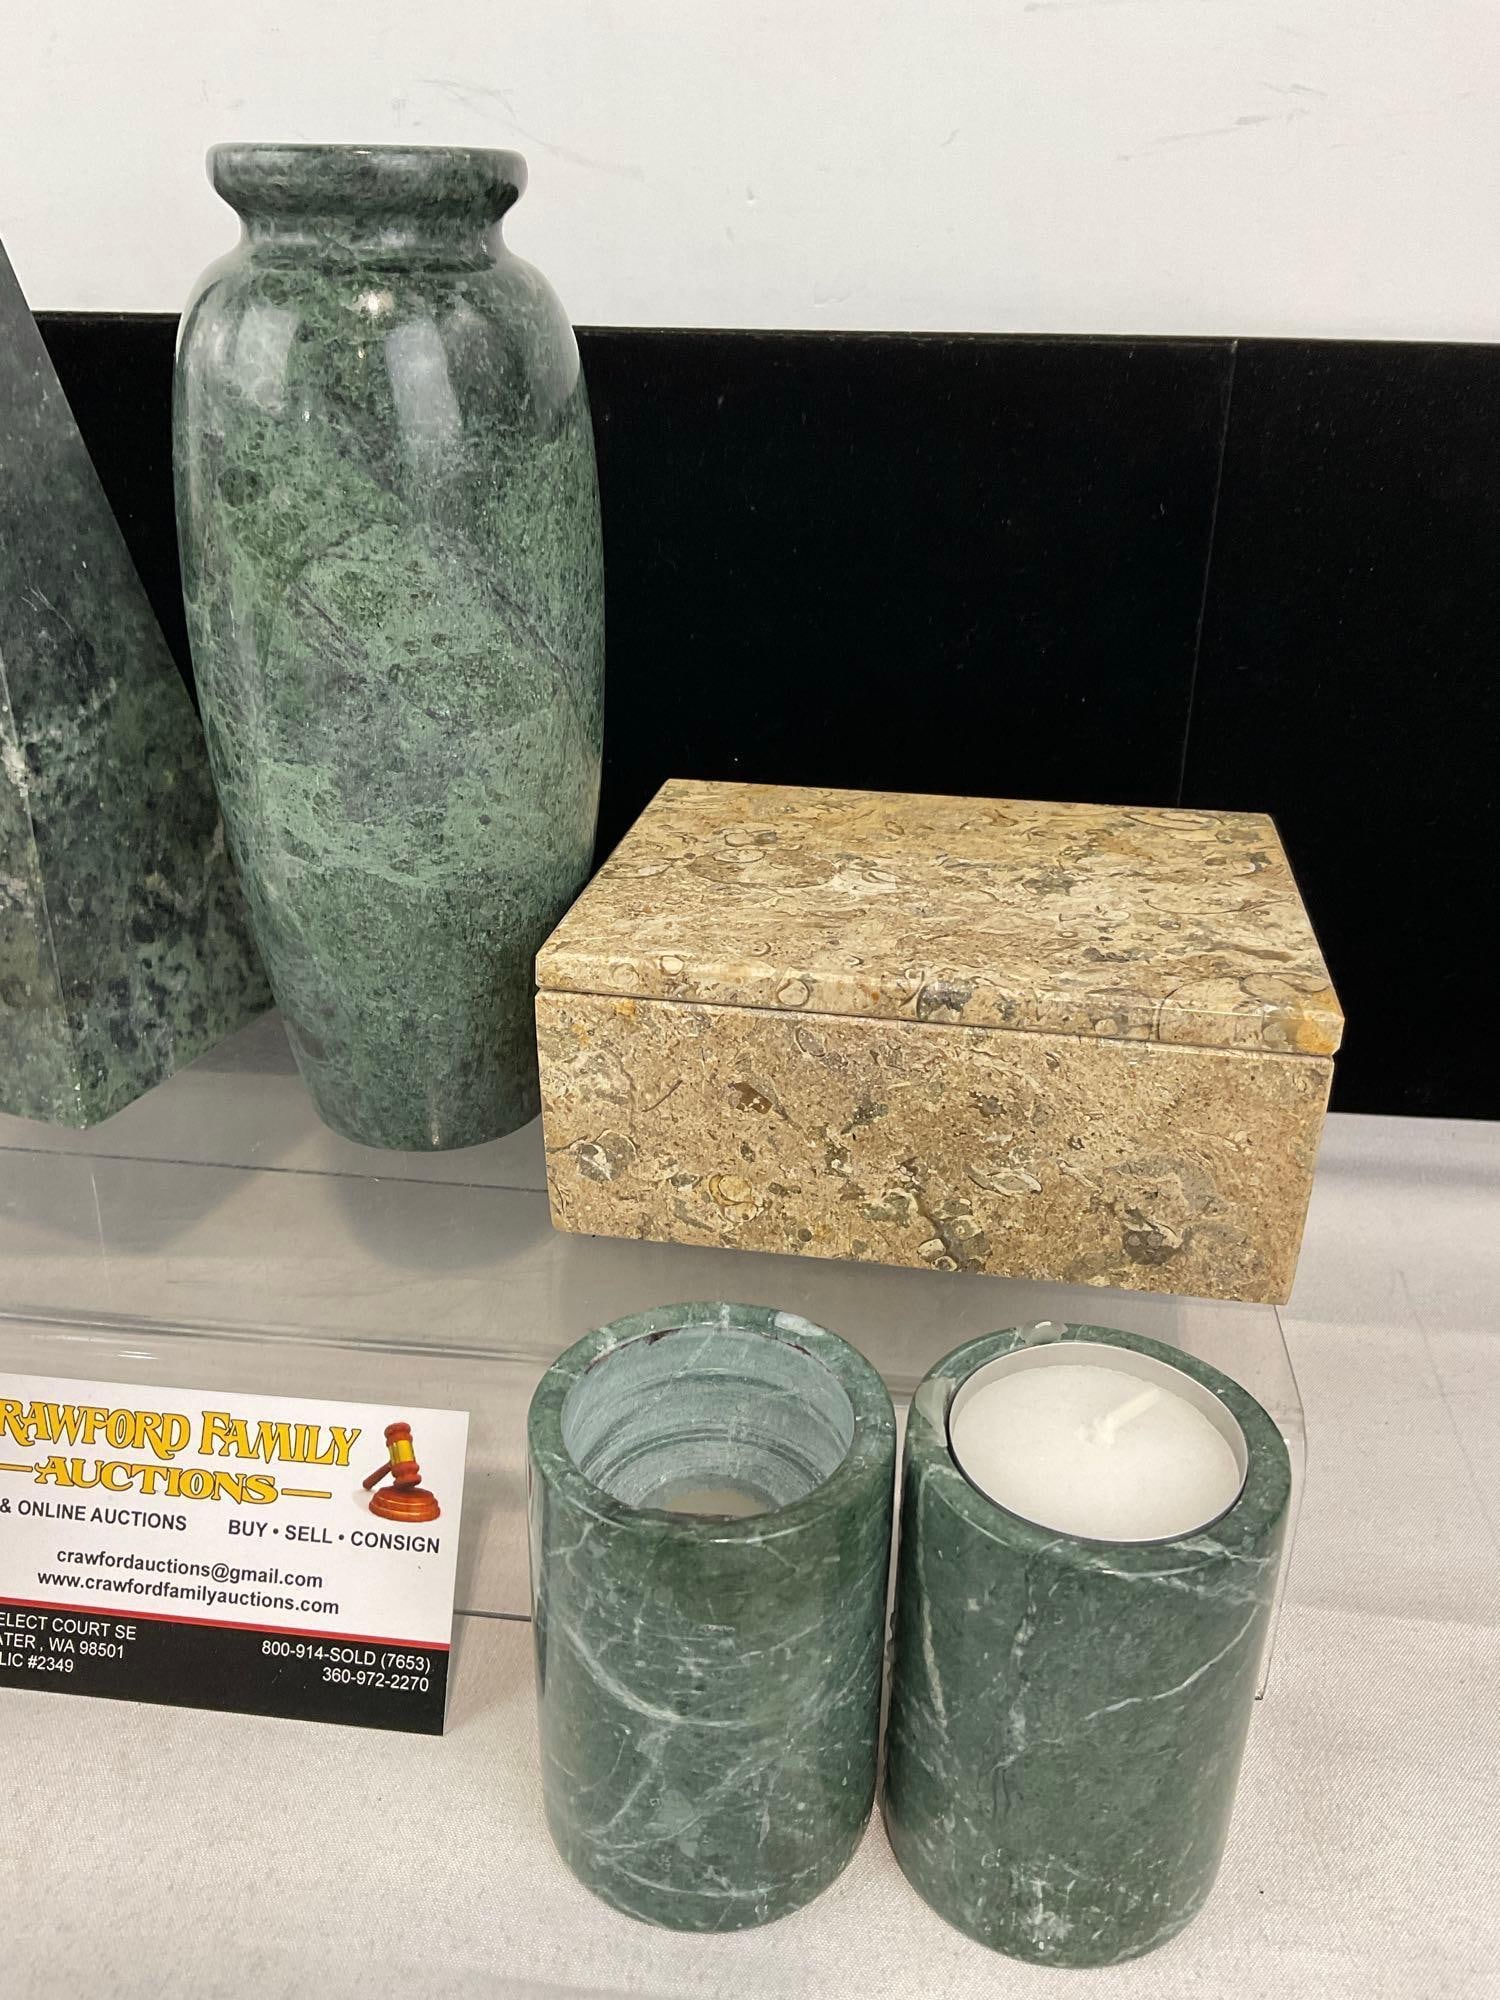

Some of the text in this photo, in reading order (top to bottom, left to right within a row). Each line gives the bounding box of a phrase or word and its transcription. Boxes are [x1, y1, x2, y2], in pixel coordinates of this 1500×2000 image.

[198, 1411, 362, 1467] FAMILY
[34, 1456, 279, 1505] AUCTIONS
[17, 1499, 87, 1521] ONLINE
[90, 1506, 188, 1532] AUCTIONS
[228, 1519, 441, 1555] BUY SELL CONSIGN
[56, 1549, 324, 1589] crawfordauctions@gmail.com
[37, 1572, 340, 1616] www.crawfordfamilyauctions.com
[0, 1632, 36, 1650] TER
[48, 1637, 76, 1654] WA
[79, 1639, 125, 1659] 98501
[52, 1617, 112, 1638] COURT
[114, 1624, 137, 1641] SE
[27, 1656, 75, 1673] #2349
[261, 1640, 431, 1674] 800-914-SOLD (7653)
[322, 1667, 430, 1693] 360-972-2270
